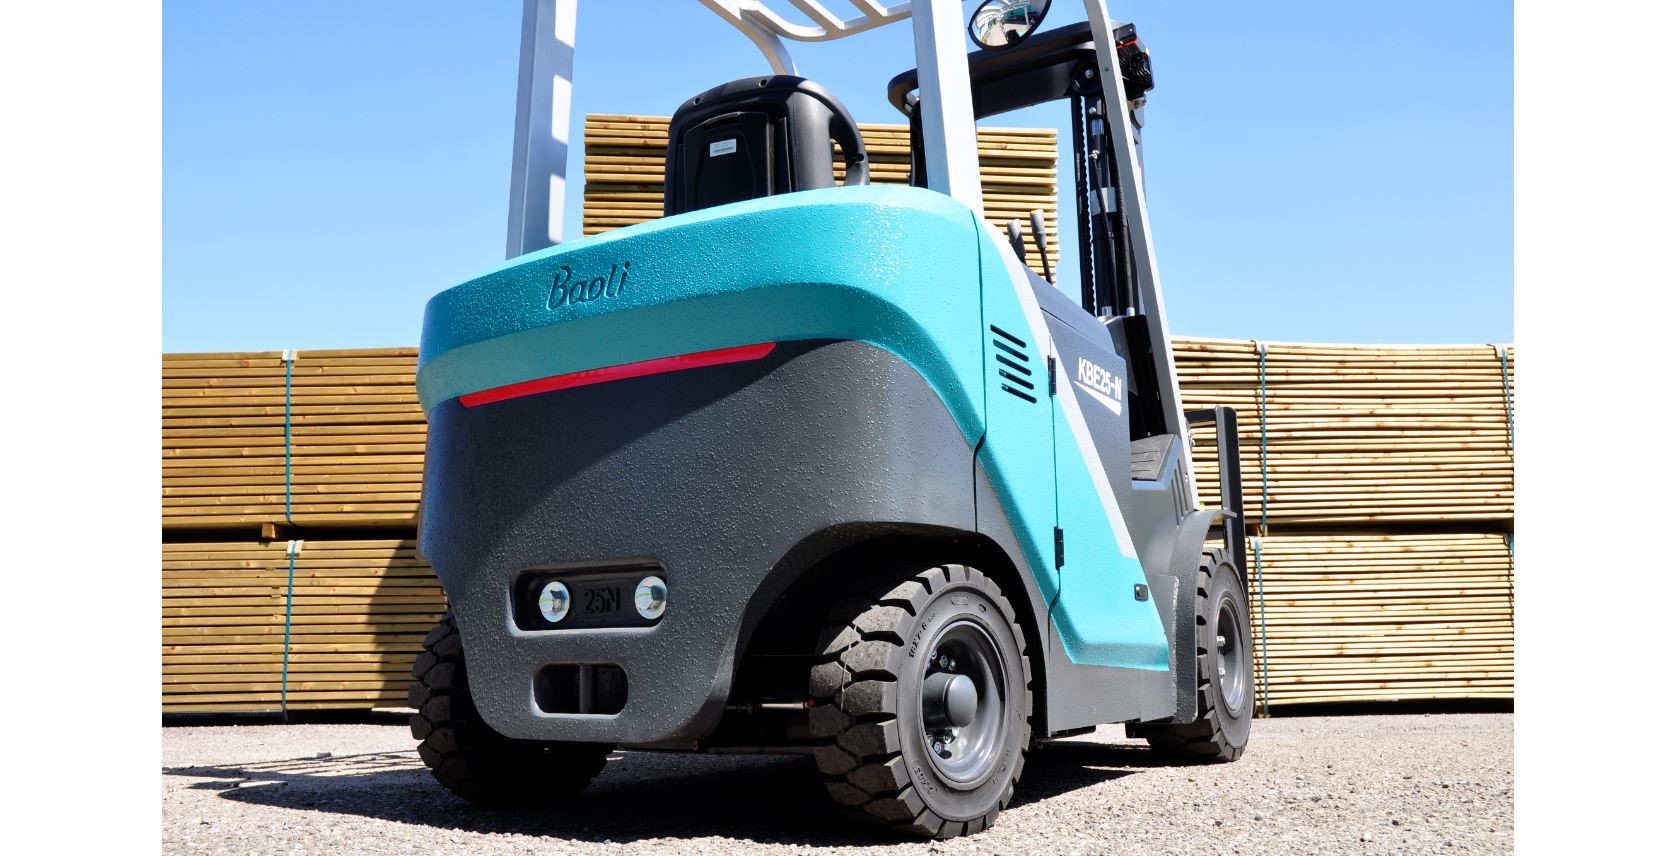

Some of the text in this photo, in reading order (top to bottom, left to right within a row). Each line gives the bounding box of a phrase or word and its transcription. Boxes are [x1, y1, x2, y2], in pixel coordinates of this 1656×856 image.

[545, 261, 631, 311] Baoli
[1078, 357, 1122, 401] KBE25-N
[584, 587, 620, 613] 25N
